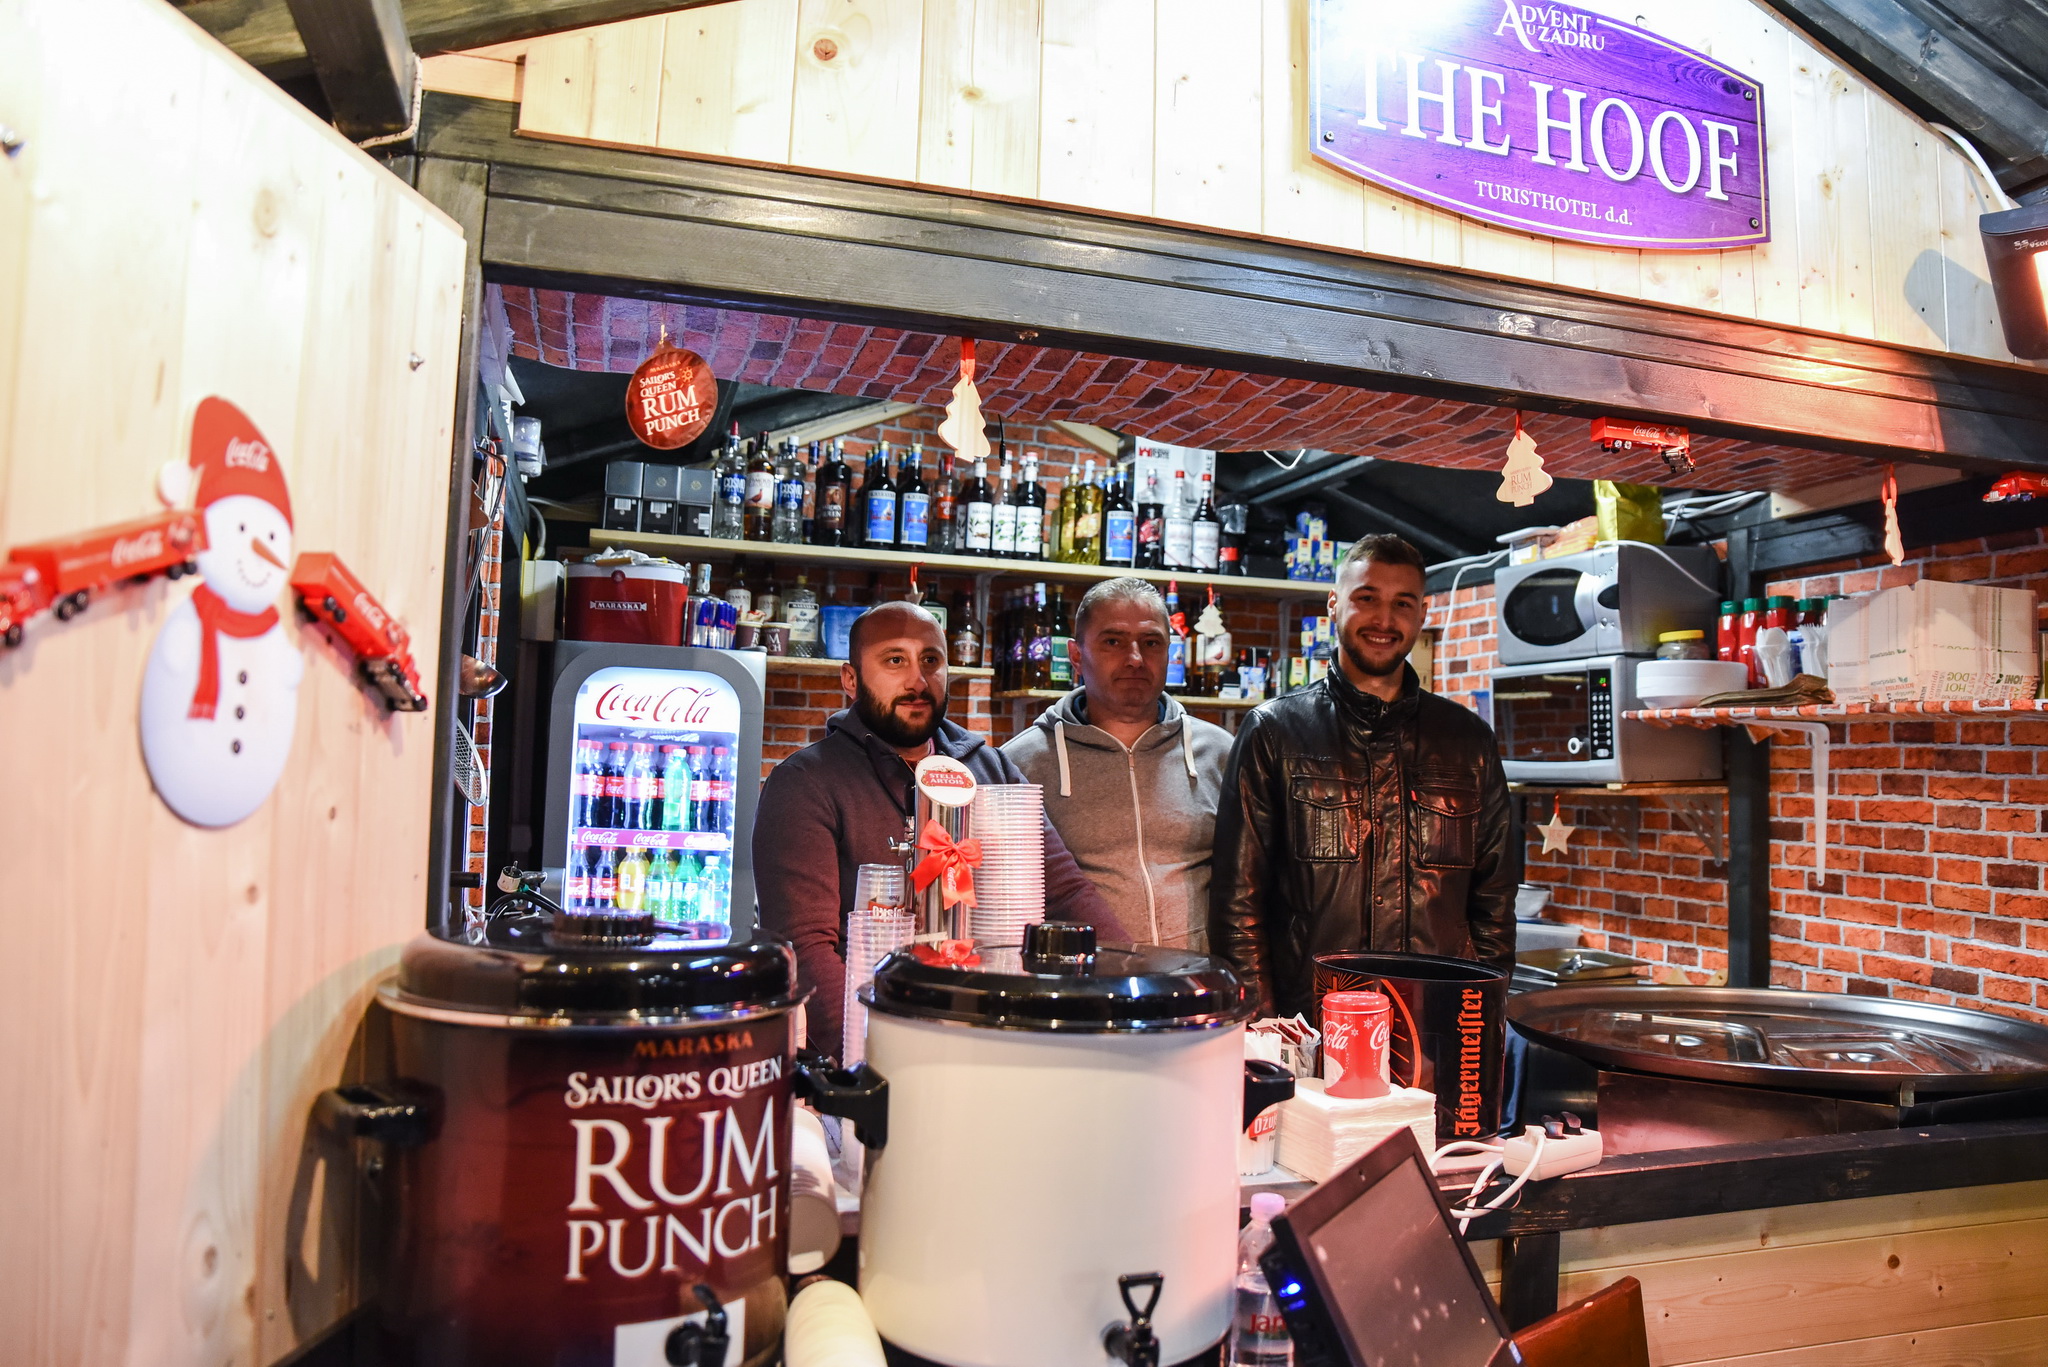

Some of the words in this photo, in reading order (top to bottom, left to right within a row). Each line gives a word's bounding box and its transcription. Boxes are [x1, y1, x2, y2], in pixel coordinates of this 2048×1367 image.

[1493, 0, 1591, 52] ADVENT
[1526, 24, 1536, 35] U
[1538, 26, 1605, 51] ZADRU
[1344, 39, 1511, 157] THE
[1528, 80, 1740, 202] HOOF
[1474, 179, 1602, 221] TURISTHOTEL
[1604, 207, 1634, 227] d.d.
[640, 380, 677, 398] QUEEN
[641, 384, 699, 420] RUM
[645, 408, 700, 436] PUNCH
[1511, 471, 1532, 486] RUM
[597, 602, 639, 610] MARASKA
[635, 1030, 754, 1057] MARASKA
[564, 1071, 701, 1109] SAILOR'S
[707, 1055, 783, 1098] QUEEN
[567, 1095, 779, 1211] RUM
[566, 1184, 778, 1281] PUNCH
